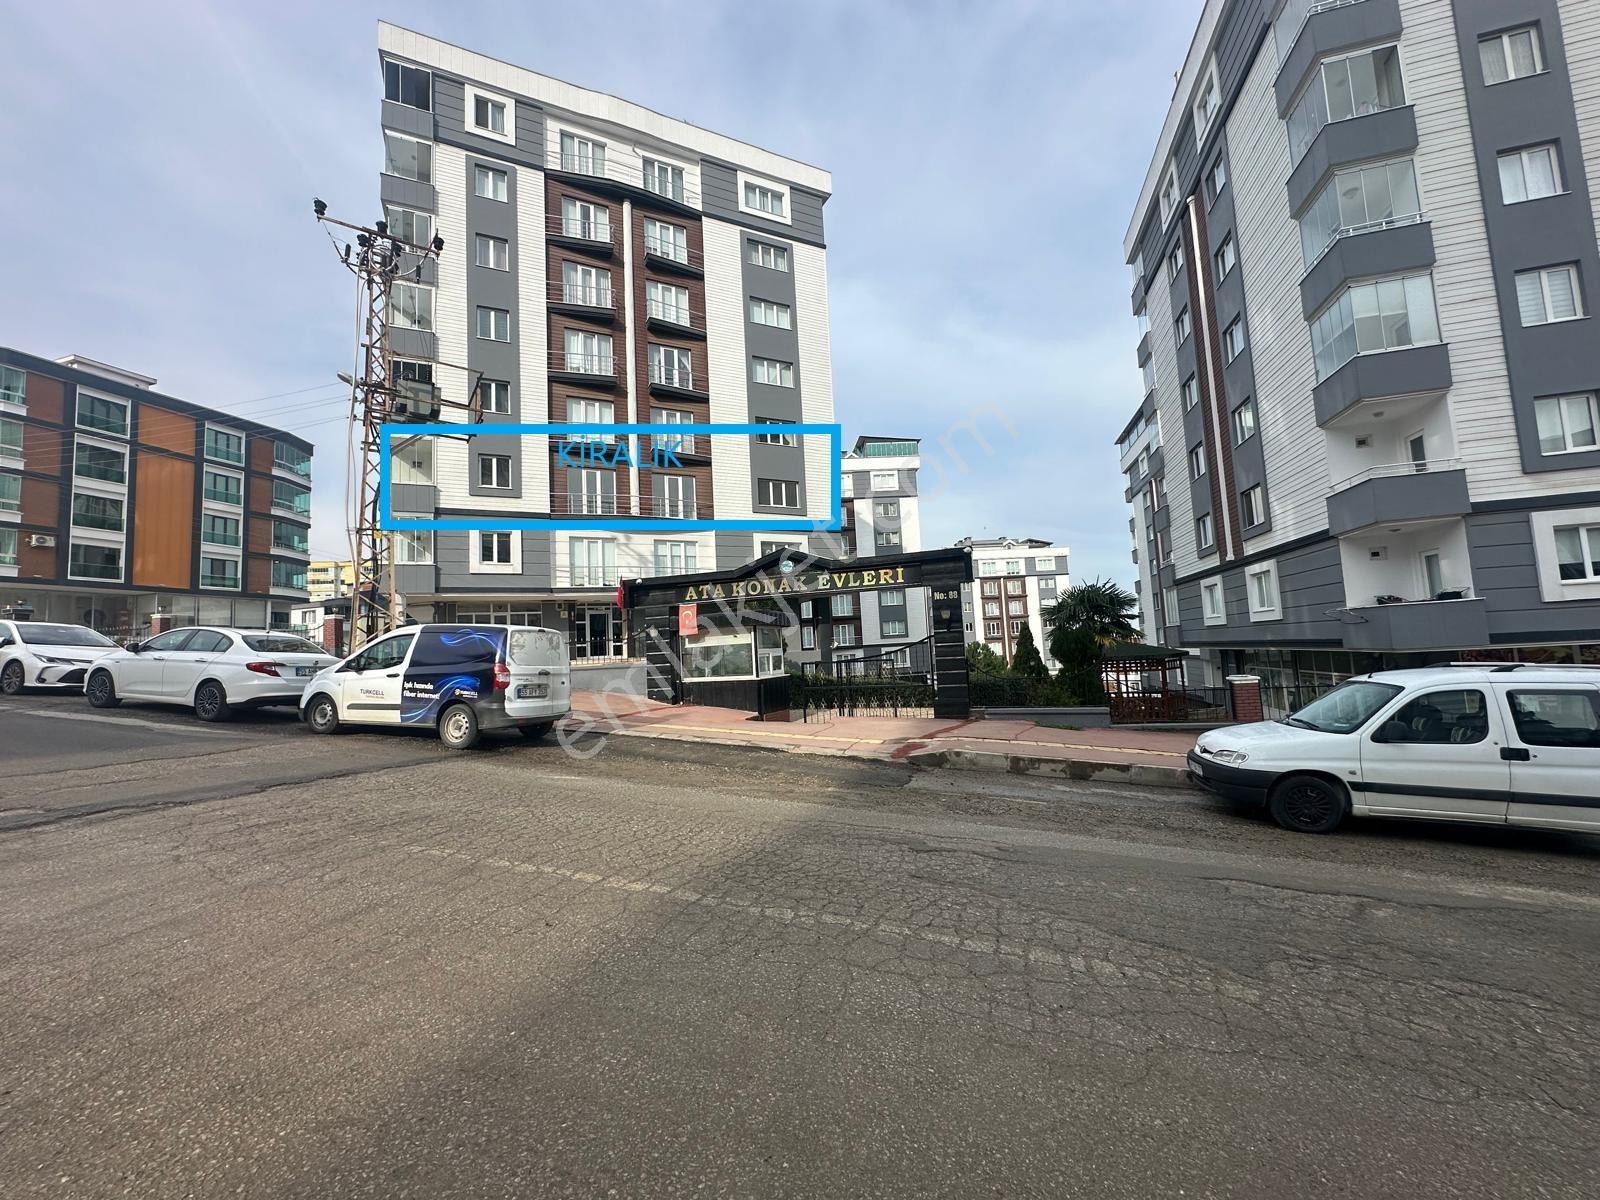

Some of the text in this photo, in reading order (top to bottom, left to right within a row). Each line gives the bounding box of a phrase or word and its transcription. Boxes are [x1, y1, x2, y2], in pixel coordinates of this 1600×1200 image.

[685, 566, 906, 601] ATA KONAK EVLERİ
[934, 590, 958, 600] No: 88
[360, 688, 385, 696] TURKCELL
[403, 690, 417, 698] fiber
